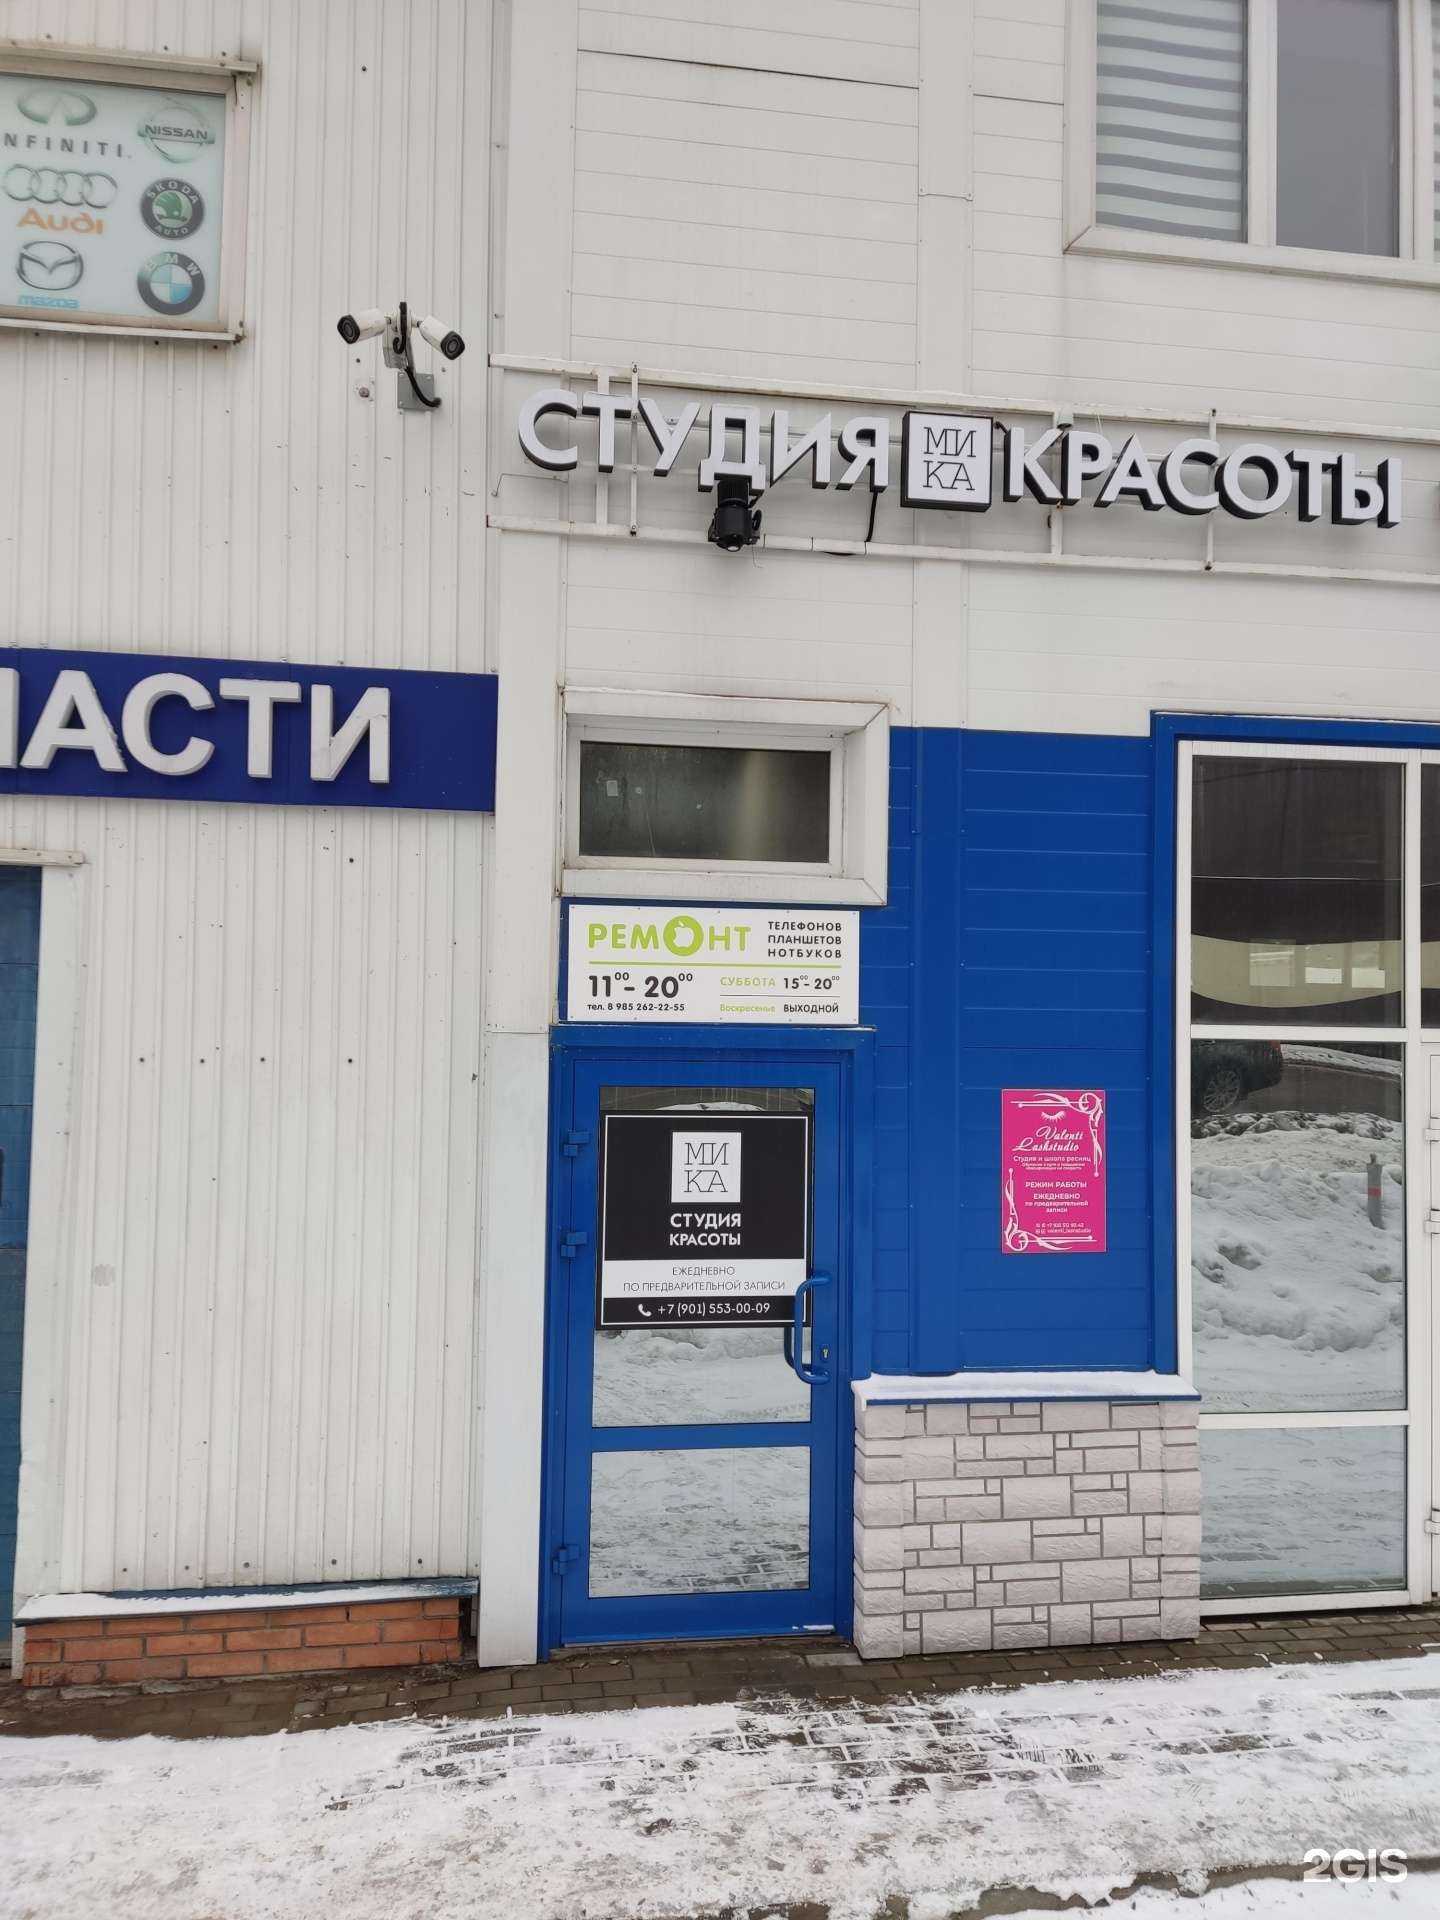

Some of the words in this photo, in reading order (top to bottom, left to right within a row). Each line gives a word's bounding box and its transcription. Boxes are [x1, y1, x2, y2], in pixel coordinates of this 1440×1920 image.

[144, 124, 208, 140] NISSAN
[17, 207, 104, 234] Audi
[154, 225, 189, 237] AUTO
[518, 388, 890, 495] СТУДИЯ
[1003, 427, 1401, 528] КРАСОТЫ
[768, 921, 842, 931] ТЕЛЕФОНОВ
[587, 915, 752, 957] РЕМОНТ
[768, 934, 842, 945] ПЛАНШЕТОВ
[768, 948, 842, 958] НОТБУКОВ
[720, 976, 776, 987] СУББОТА
[587, 1003, 605, 1011] тел.
[607, 1002, 614, 1011] 8
[616, 1003, 634, 1011] 985
[636, 1003, 685, 1011] 262-22-55
[783, 1002, 840, 1014] ВЫХОДНОЙ
[684, 1142, 730, 1166] МИ
[683, 1169, 729, 1193] КА
[1025, 1181, 1054, 1189] РЕЖИМ
[1055, 1181, 1087, 1189] РАБОТЫ
[670, 1213, 742, 1230] СТУДИЯ
[669, 1233, 741, 1247] КРАСОТЫ
[672, 1266, 736, 1277] ЕЖЕДНЕВНО
[623, 1282, 640, 1292] ПО
[642, 1279, 741, 1292] ПРЕДВАРИТЕЛЬНОЙ
[743, 1280, 786, 1291] ЗАПИСИ
[658, 1304, 674, 1315] +7
[677, 1302, 706, 1317] (901)
[708, 1302, 771, 1314] 553-00-09
